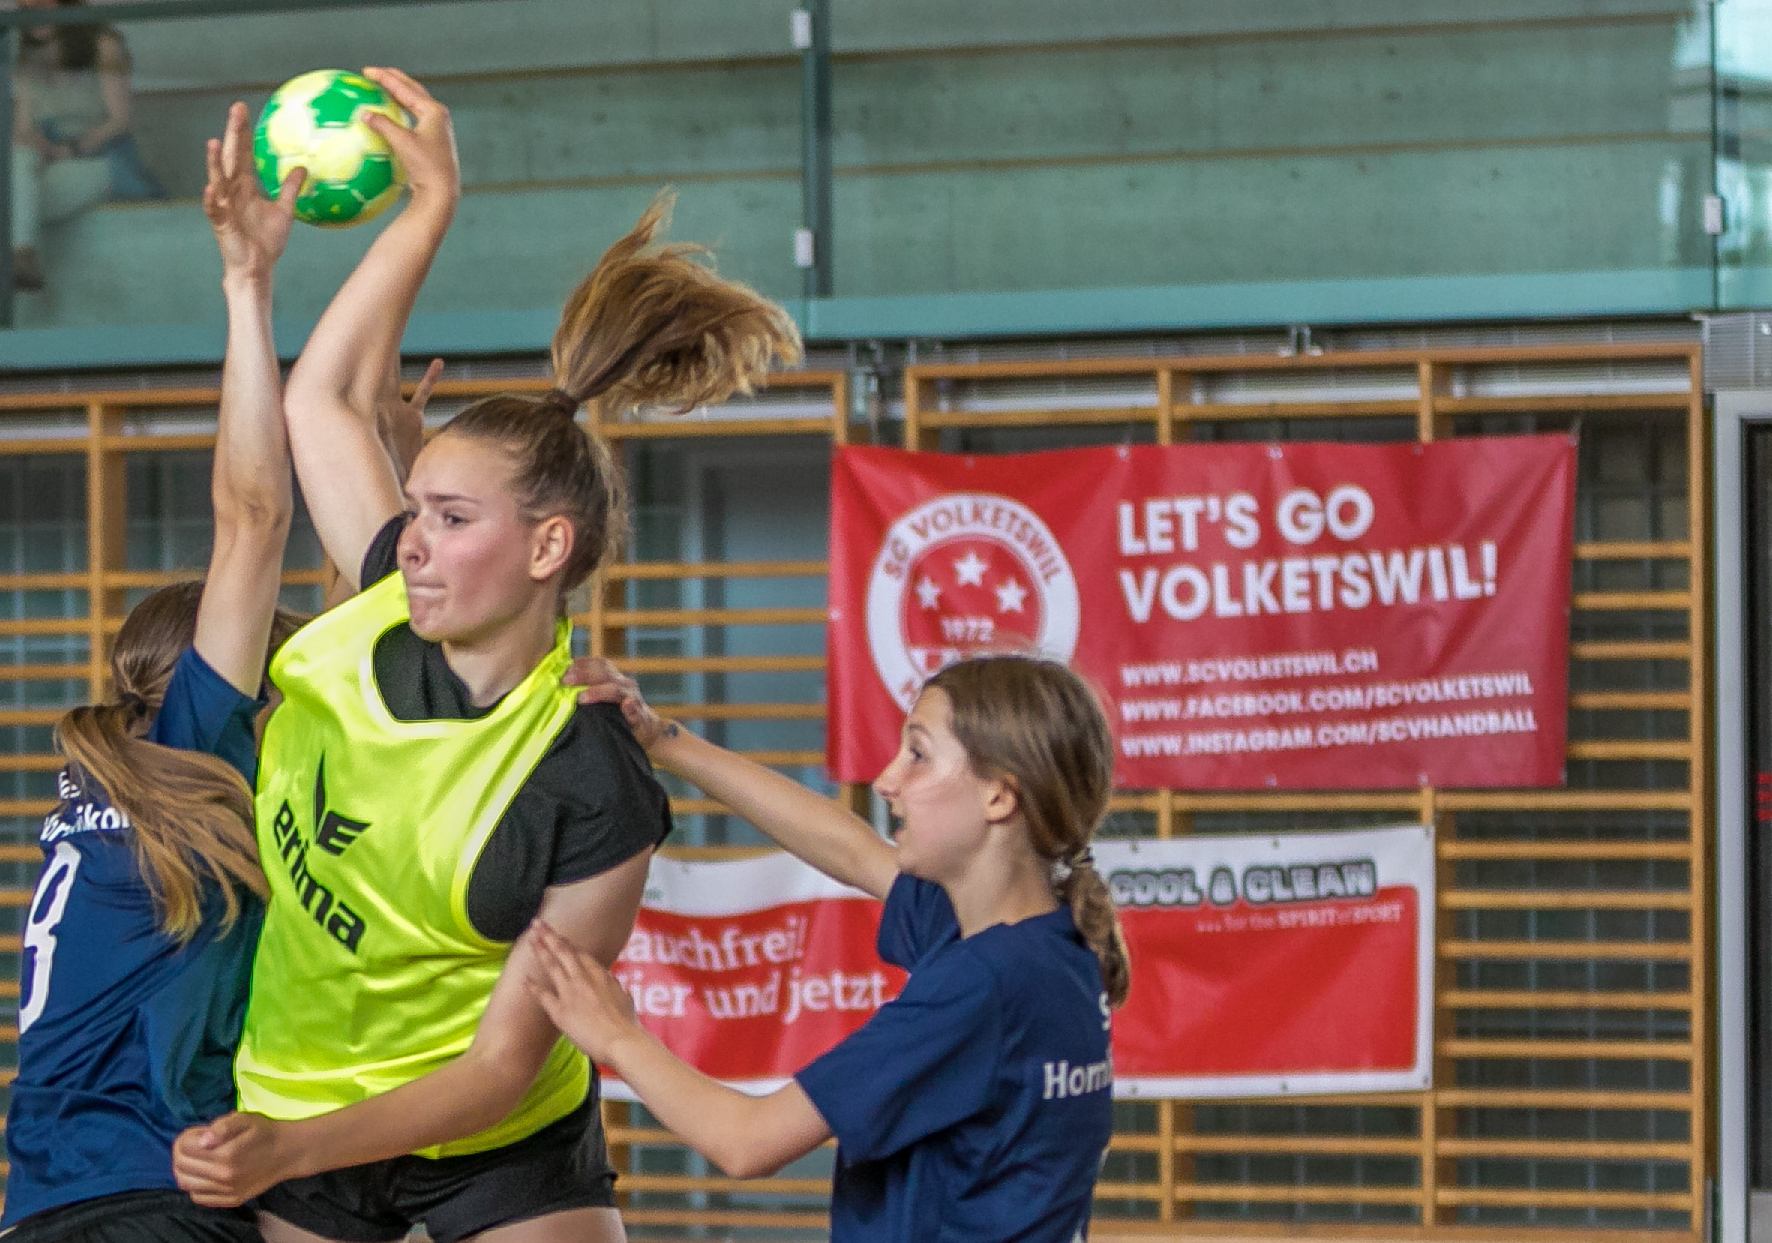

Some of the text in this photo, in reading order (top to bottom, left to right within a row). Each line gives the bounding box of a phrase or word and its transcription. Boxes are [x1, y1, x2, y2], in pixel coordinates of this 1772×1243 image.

[884, 502, 1062, 586] SC VOLKETSWIL
[1117, 484, 1376, 556] LET'S GO
[1118, 540, 1499, 624] VOLKETSWIL!
[1120, 649, 1379, 687] WWW.SCVOLKETSWIL.CH
[1120, 672, 1535, 721] WWW.FACEBOOK.COM/SCVOLKETSWIL
[1120, 709, 1537, 758] WWW.INSTAGRAM.COM/SCVHANDBALL
[273, 799, 366, 955] erima
[1107, 867, 1203, 906] COOL
[1242, 858, 1377, 905] CLEAN
[619, 914, 807, 972] auchfrei!
[618, 968, 694, 1017] ier
[703, 968, 782, 1019] und
